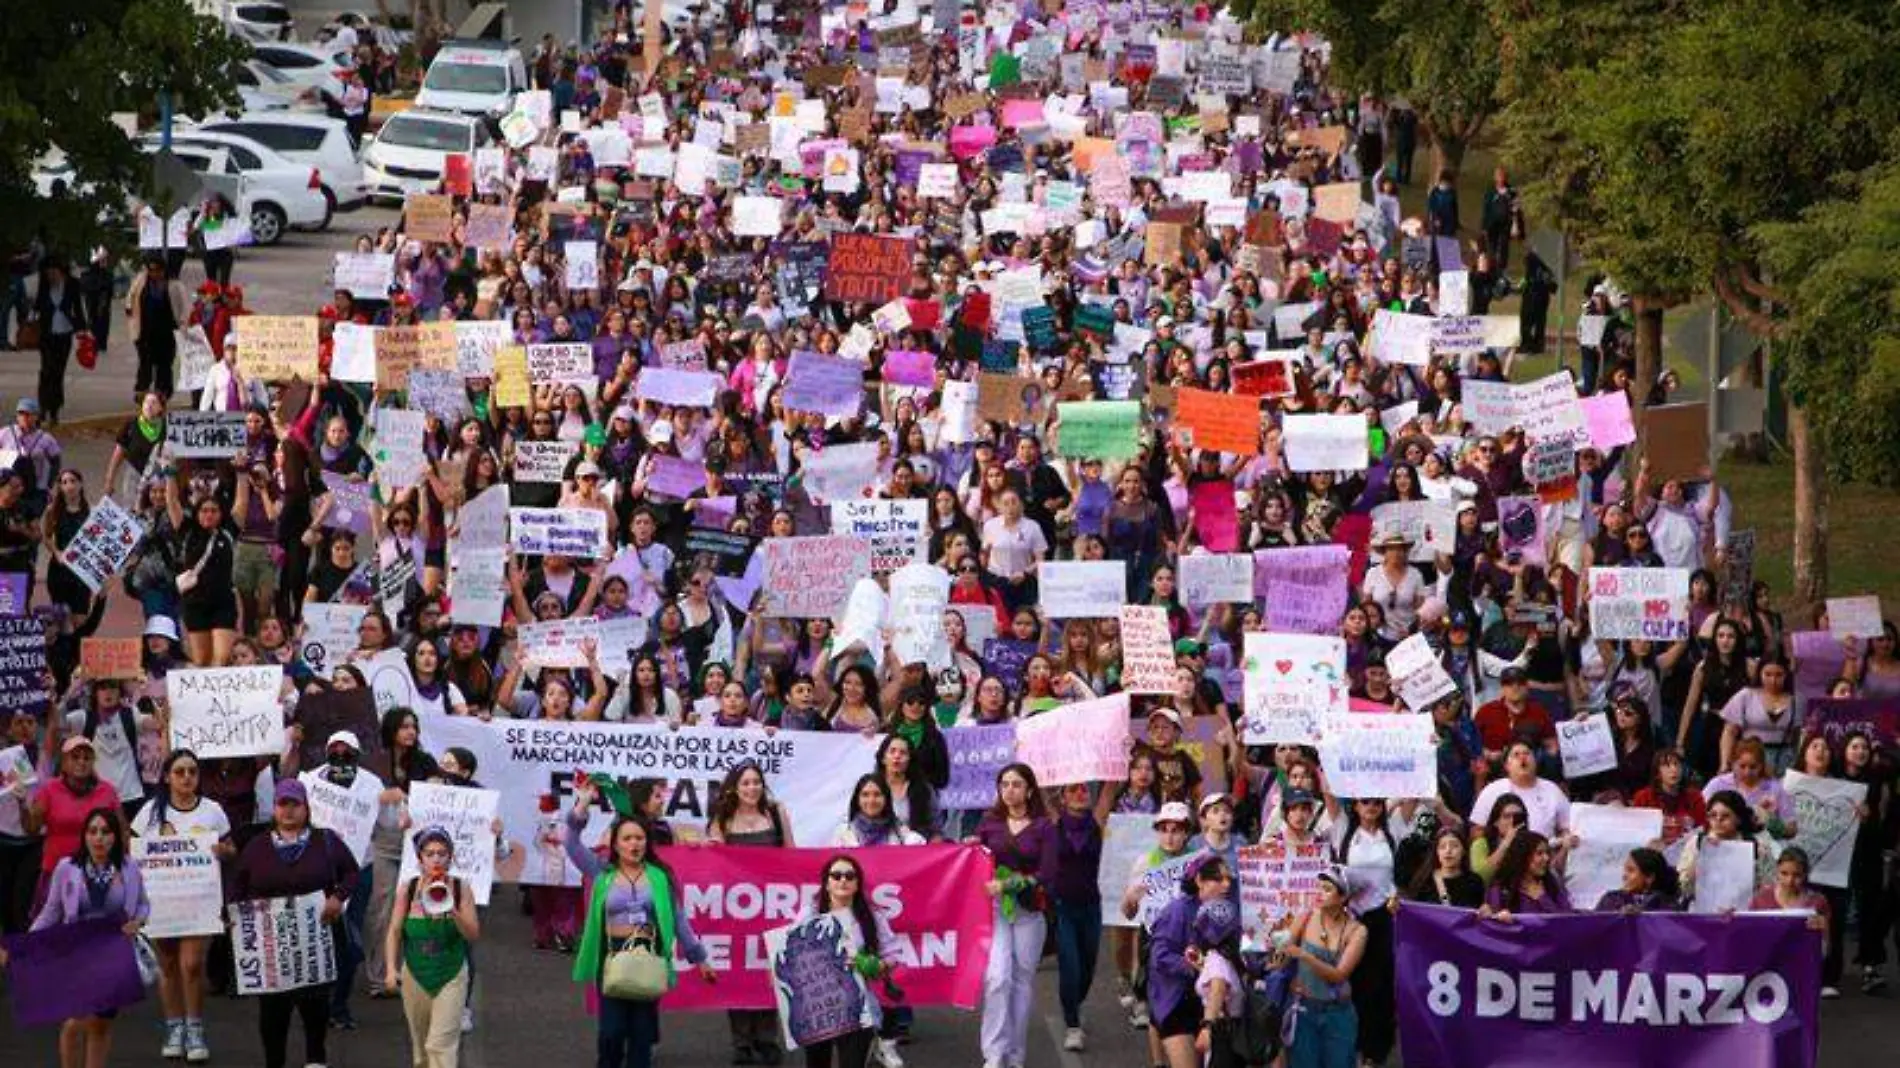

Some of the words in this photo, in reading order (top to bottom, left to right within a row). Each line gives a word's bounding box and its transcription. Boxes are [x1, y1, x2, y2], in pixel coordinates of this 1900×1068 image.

[505, 728, 526, 744] SE
[532, 730, 669, 751] ESCANDALIZAN
[675, 735, 712, 753] POR
[717, 738, 748, 755] LAS
[755, 740, 794, 757] QUE
[512, 747, 604, 764] MARCHAN
[610, 751, 620, 766] Y
[627, 752, 656, 767] NO
[662, 754, 699, 770] POR
[705, 756, 735, 773] LAS
[683, 882, 904, 920] MORS
[1427, 960, 1460, 1017] 8
[1476, 966, 1556, 1021] DE
[1571, 969, 1789, 1026] MARZO
